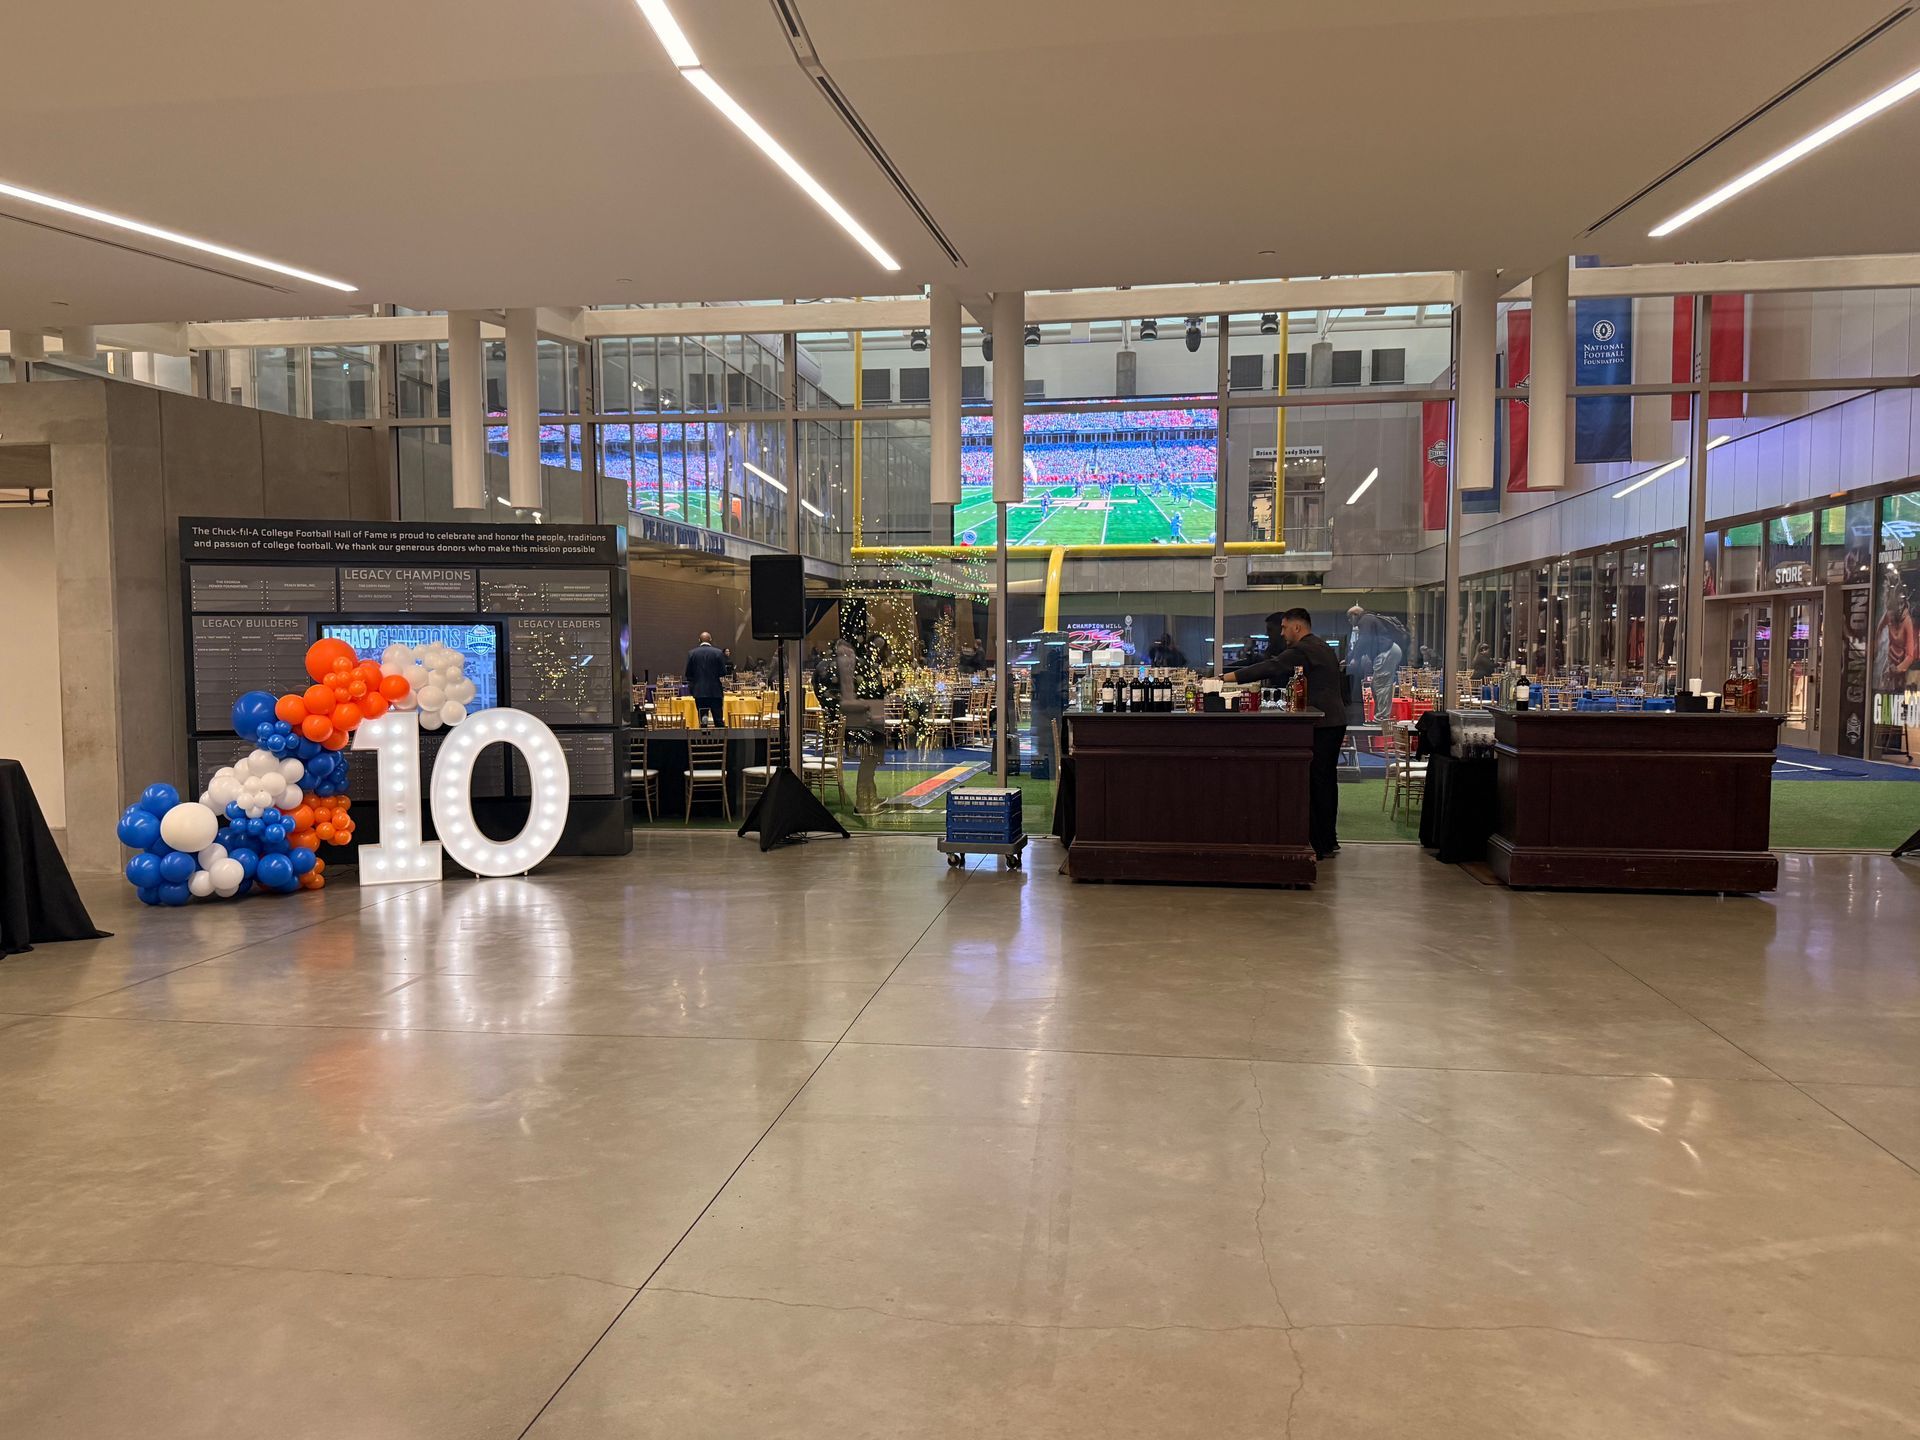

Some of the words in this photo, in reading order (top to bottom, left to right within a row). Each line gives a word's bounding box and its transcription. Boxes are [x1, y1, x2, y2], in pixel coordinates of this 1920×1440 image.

[1584, 343, 1624, 351] NATIONAL
[1584, 351, 1624, 359] FOOTBALL
[192, 527, 209, 535] The
[212, 527, 259, 536] Chick-fil-A
[261, 529, 293, 539] College
[296, 529, 332, 538] Football
[334, 530, 350, 538] Hall
[353, 530, 362, 538] of
[364, 531, 388, 539] Fame
[390, 531, 397, 539] is
[399, 531, 424, 541] proud
[437, 532, 475, 540] celebrate
[521, 533, 535, 541] the
[537, 533, 566, 543] people,
[568, 533, 606, 542] traditions
[214, 540, 249, 549] passion
[252, 540, 261, 548] of
[263, 541, 294, 550] college
[297, 541, 333, 550] football.
[395, 544, 435, 553] generous
[437, 544, 466, 552] donors
[488, 545, 510, 553] make
[512, 545, 528, 553] this
[529, 545, 560, 553] mission
[562, 545, 595, 555] possible
[345, 569, 392, 580] LEGACY
[396, 570, 471, 581] CHAMPIONS
[1775, 565, 1803, 584] STORE
[202, 619, 242, 628] LEGACY
[246, 619, 298, 628] BUILDERS
[518, 620, 554, 628] LEGACY
[557, 620, 601, 629] LEADERS
[1873, 693, 1906, 727] GAME
[350, 707, 570, 886] 10
